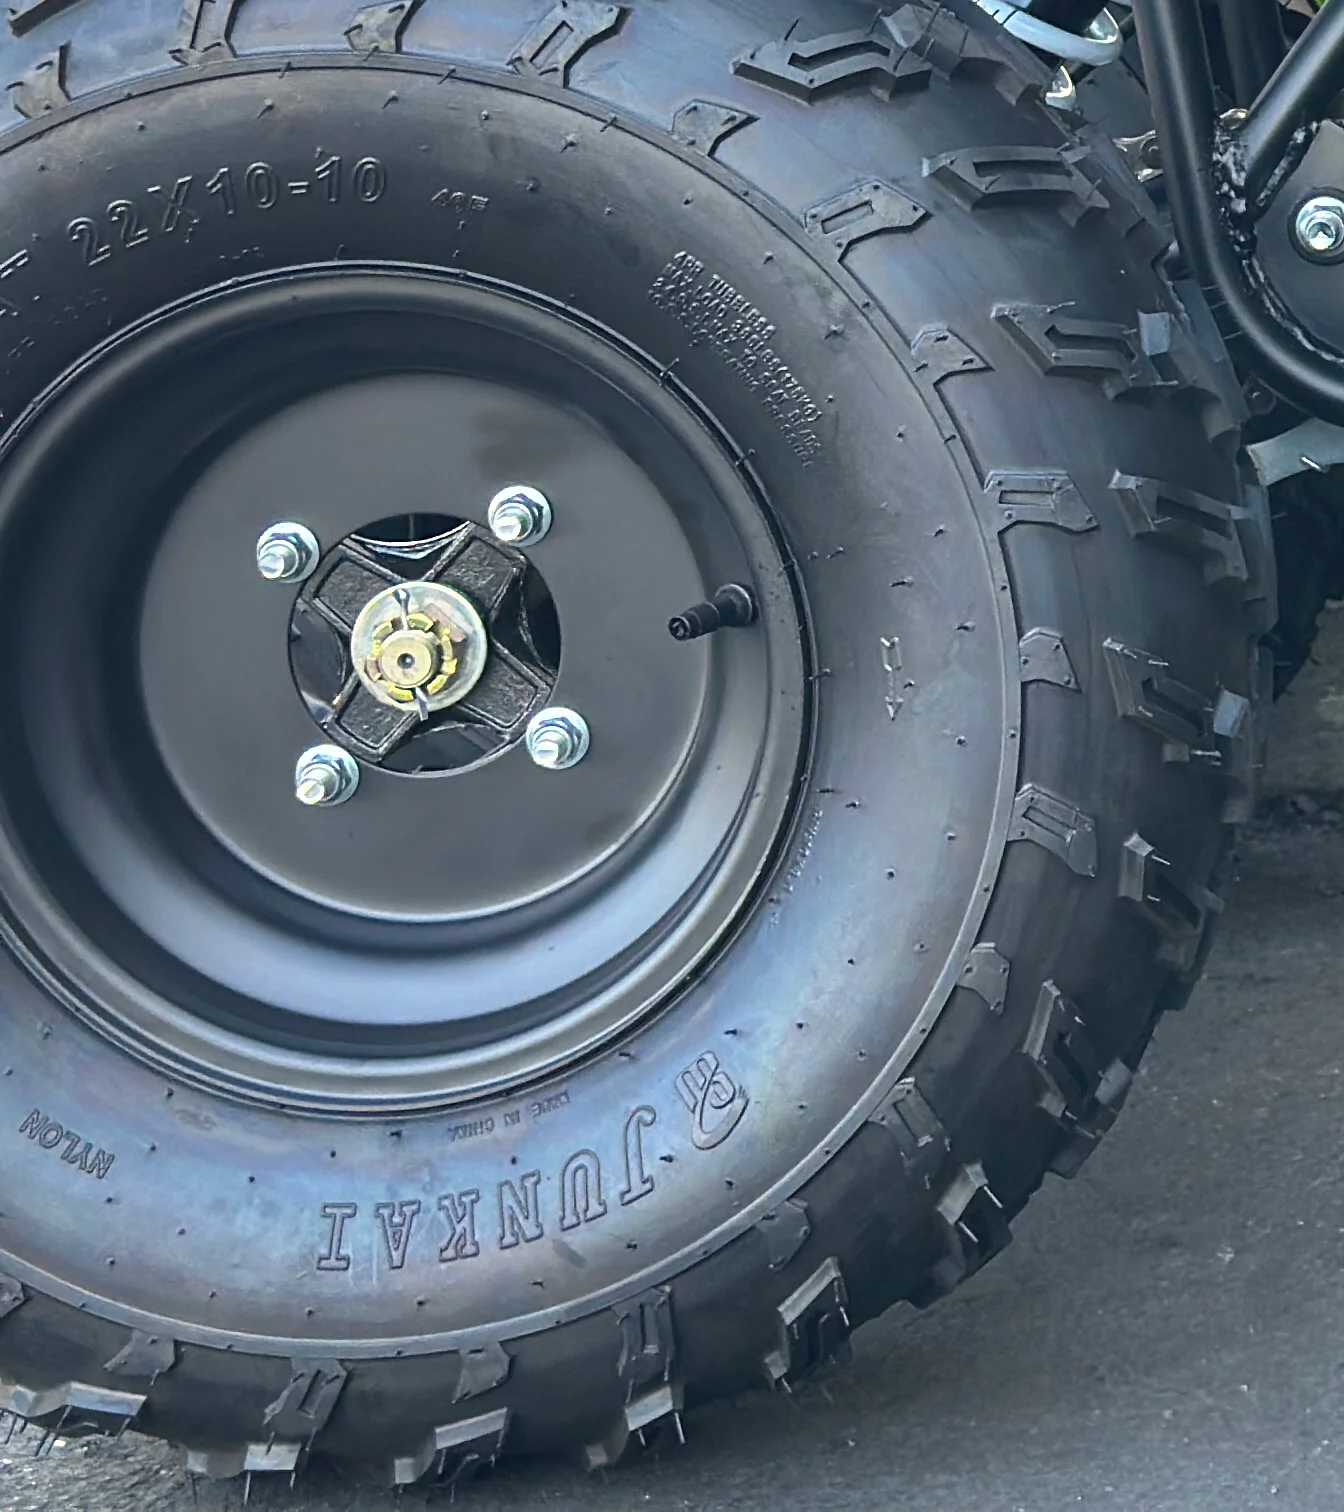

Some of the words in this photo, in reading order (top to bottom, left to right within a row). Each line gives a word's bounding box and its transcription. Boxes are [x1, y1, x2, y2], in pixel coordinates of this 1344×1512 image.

[66, 155, 387, 267] 22X10-10
[18, 1106, 115, 1181] NYLON
[315, 1103, 658, 1272] JUNKAI
